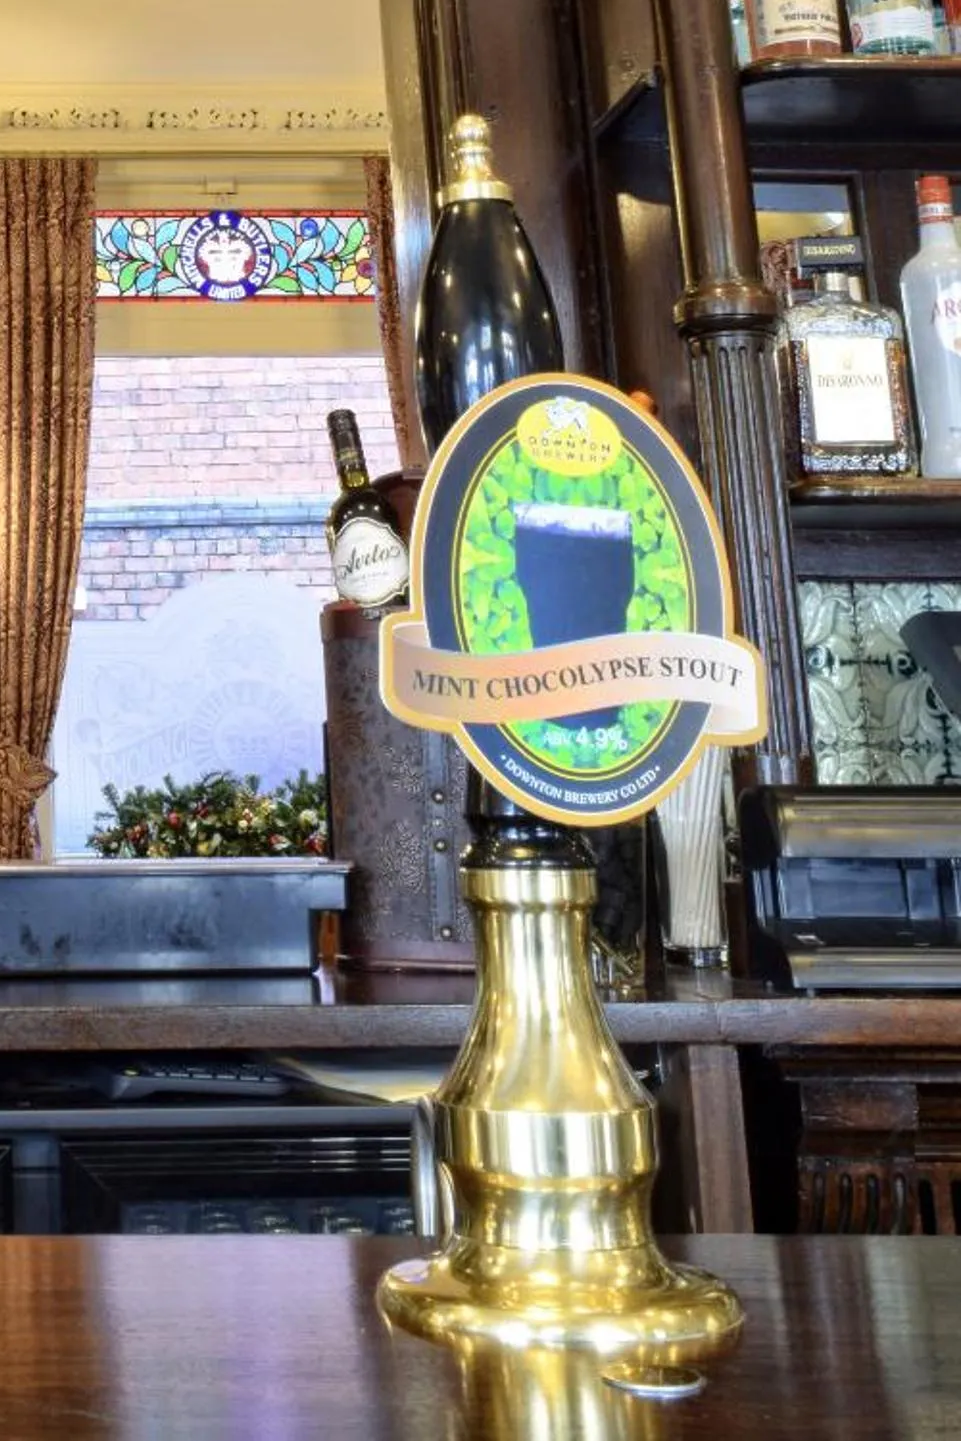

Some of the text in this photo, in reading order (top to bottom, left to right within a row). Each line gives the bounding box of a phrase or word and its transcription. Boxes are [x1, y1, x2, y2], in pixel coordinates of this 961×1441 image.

[238, 217, 271, 287] BUTLERS
[412, 656, 743, 701] MINT CHOCOLYPSE STOUT
[575, 725, 629, 751] 4.9%
[504, 757, 658, 805] DOWNTON BREWERY CO LTD
